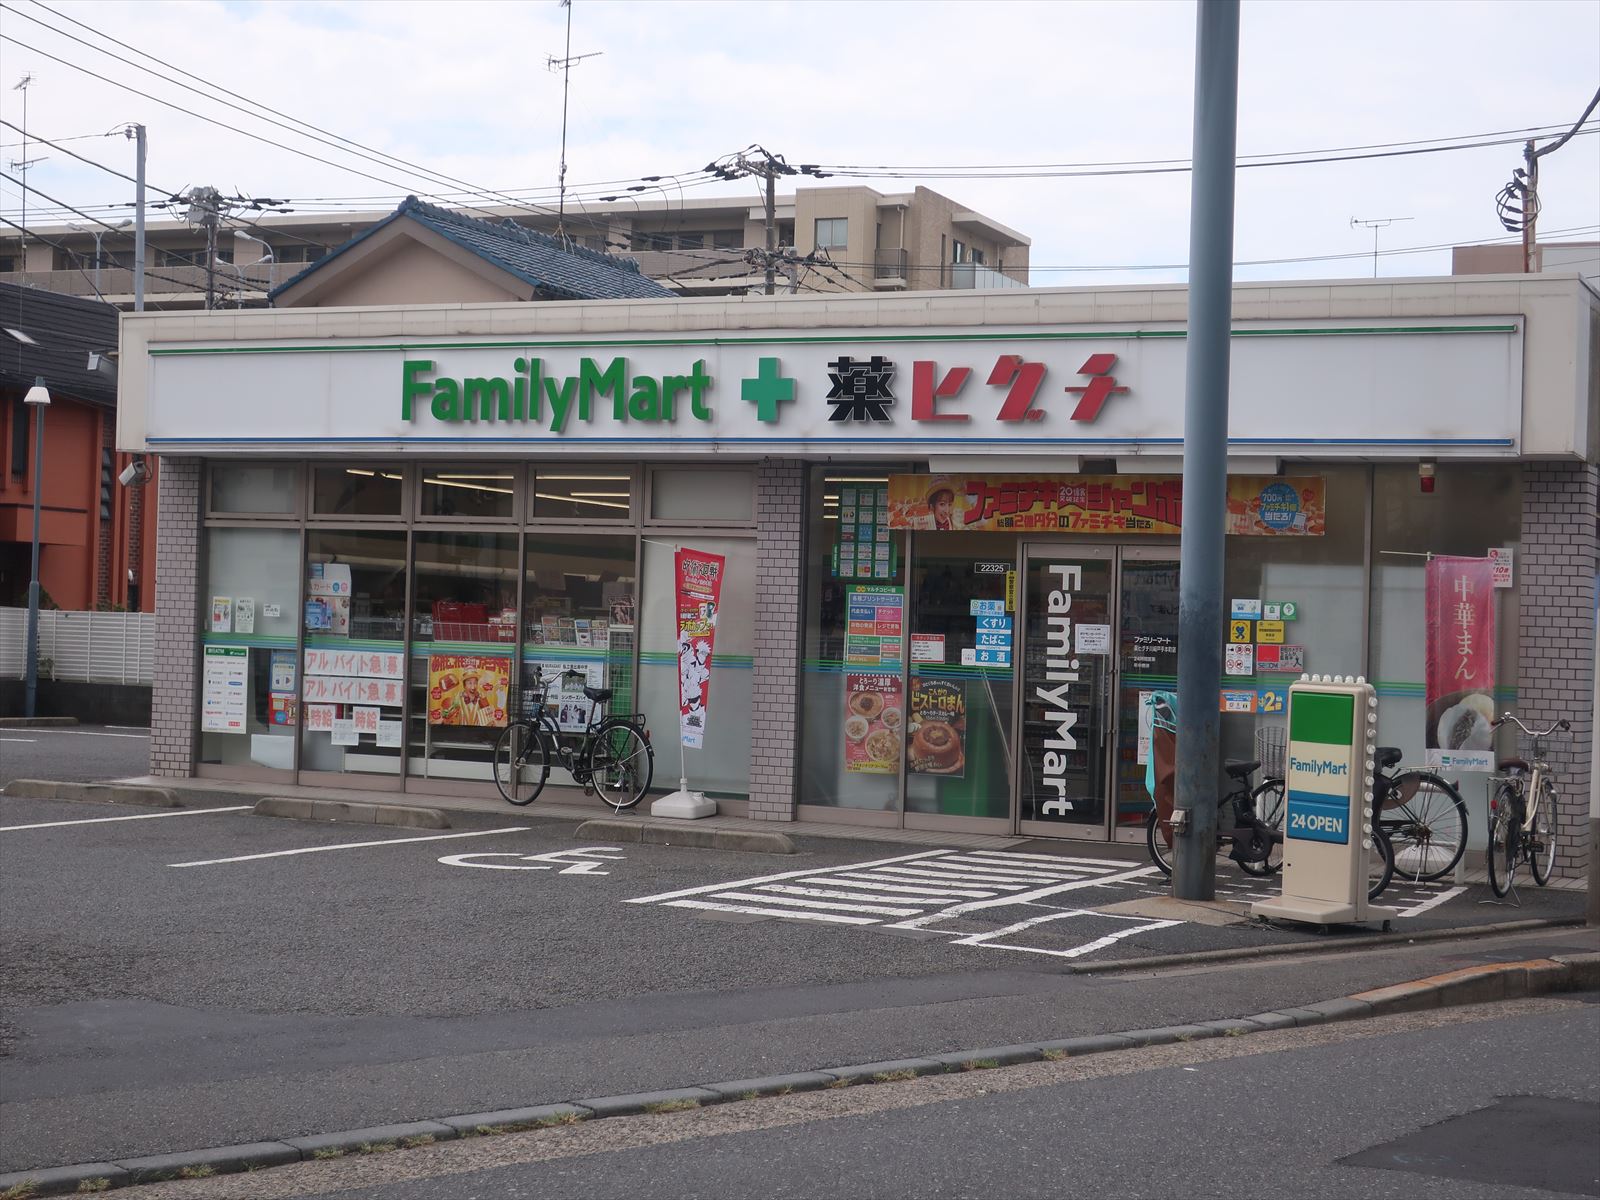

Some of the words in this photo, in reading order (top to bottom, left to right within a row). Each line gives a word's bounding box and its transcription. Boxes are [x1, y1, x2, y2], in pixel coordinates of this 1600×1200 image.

[401, 357, 713, 433] FamilyMart
[981, 564, 1004, 573] 22325
[982, 618, 1006, 629] くすり
[1453, 575, 1477, 681] 中華まん
[981, 634, 1006, 645] たばこ
[1134, 636, 1171, 644] ファミリーマート
[307, 652, 398, 674] アルバイト急募
[980, 651, 1006, 662] お酒
[1036, 565, 1082, 815] FamilyMart
[911, 690, 965, 714] ビストロまん
[1290, 757, 1347, 776] FamilyMart
[1452, 757, 1488, 766] FamilyMart
[1291, 813, 1306, 829] 24
[1307, 815, 1342, 833] OPEN
